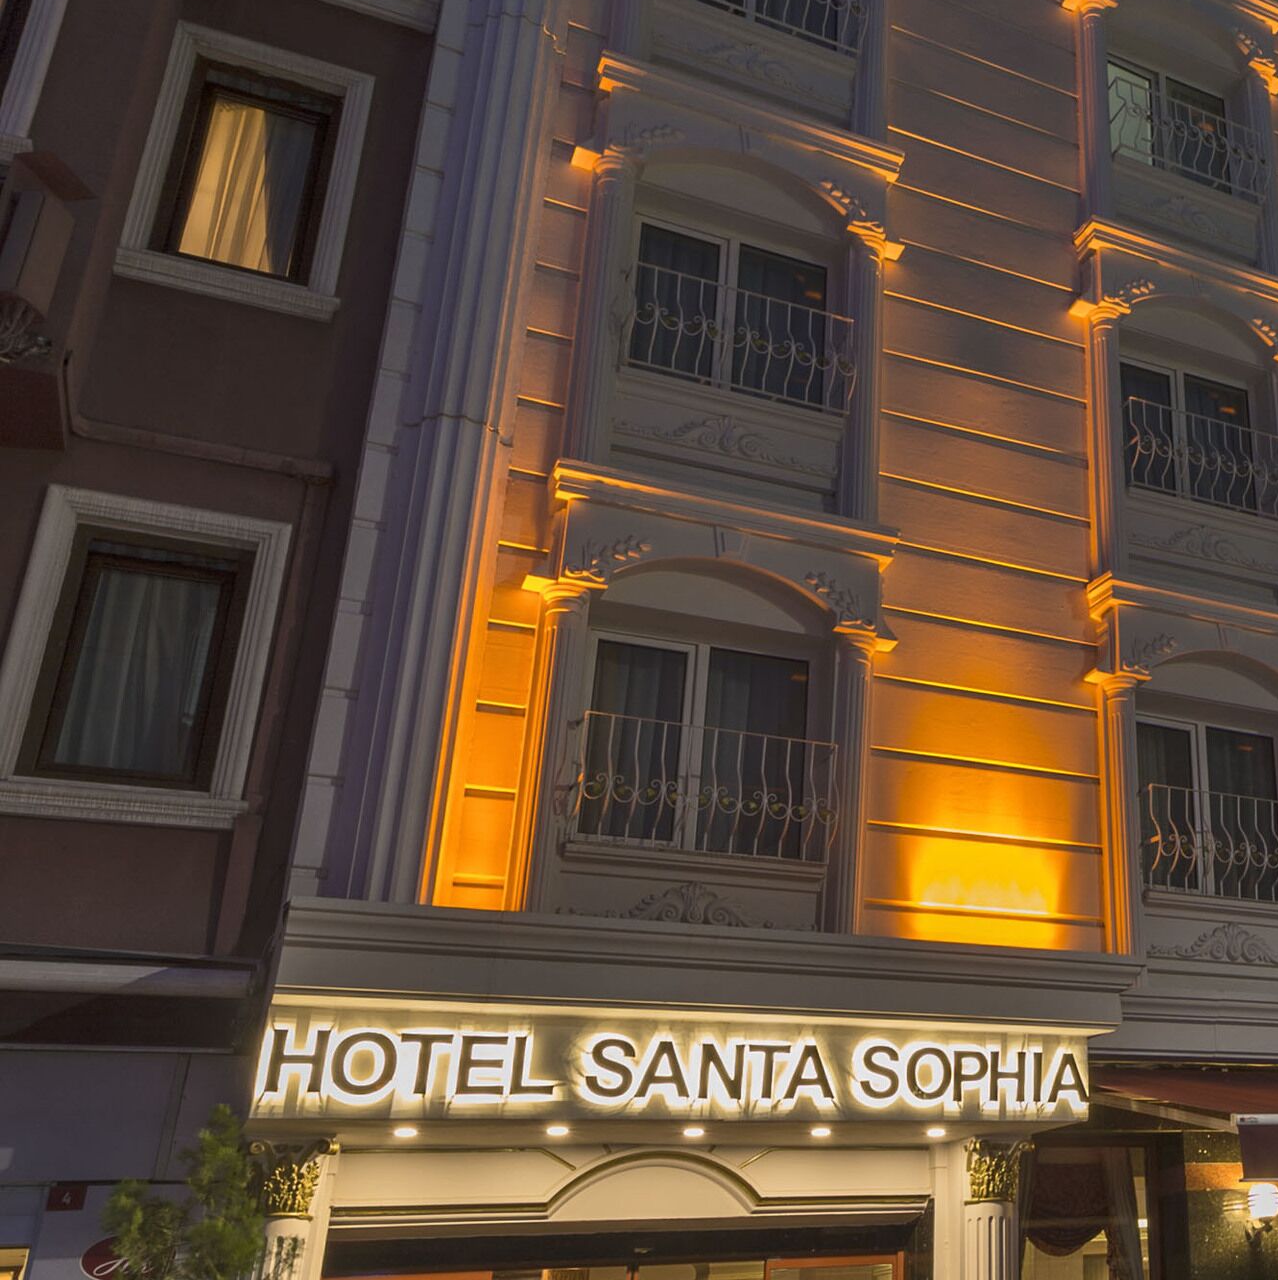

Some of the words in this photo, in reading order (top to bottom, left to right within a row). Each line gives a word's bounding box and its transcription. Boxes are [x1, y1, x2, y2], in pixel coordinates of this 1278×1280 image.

[264, 1028, 555, 1096] HOTEL
[584, 1038, 835, 1100] SANTA
[859, 1045, 1090, 1103] SOPHIA
[61, 1191, 73, 1206] 4
